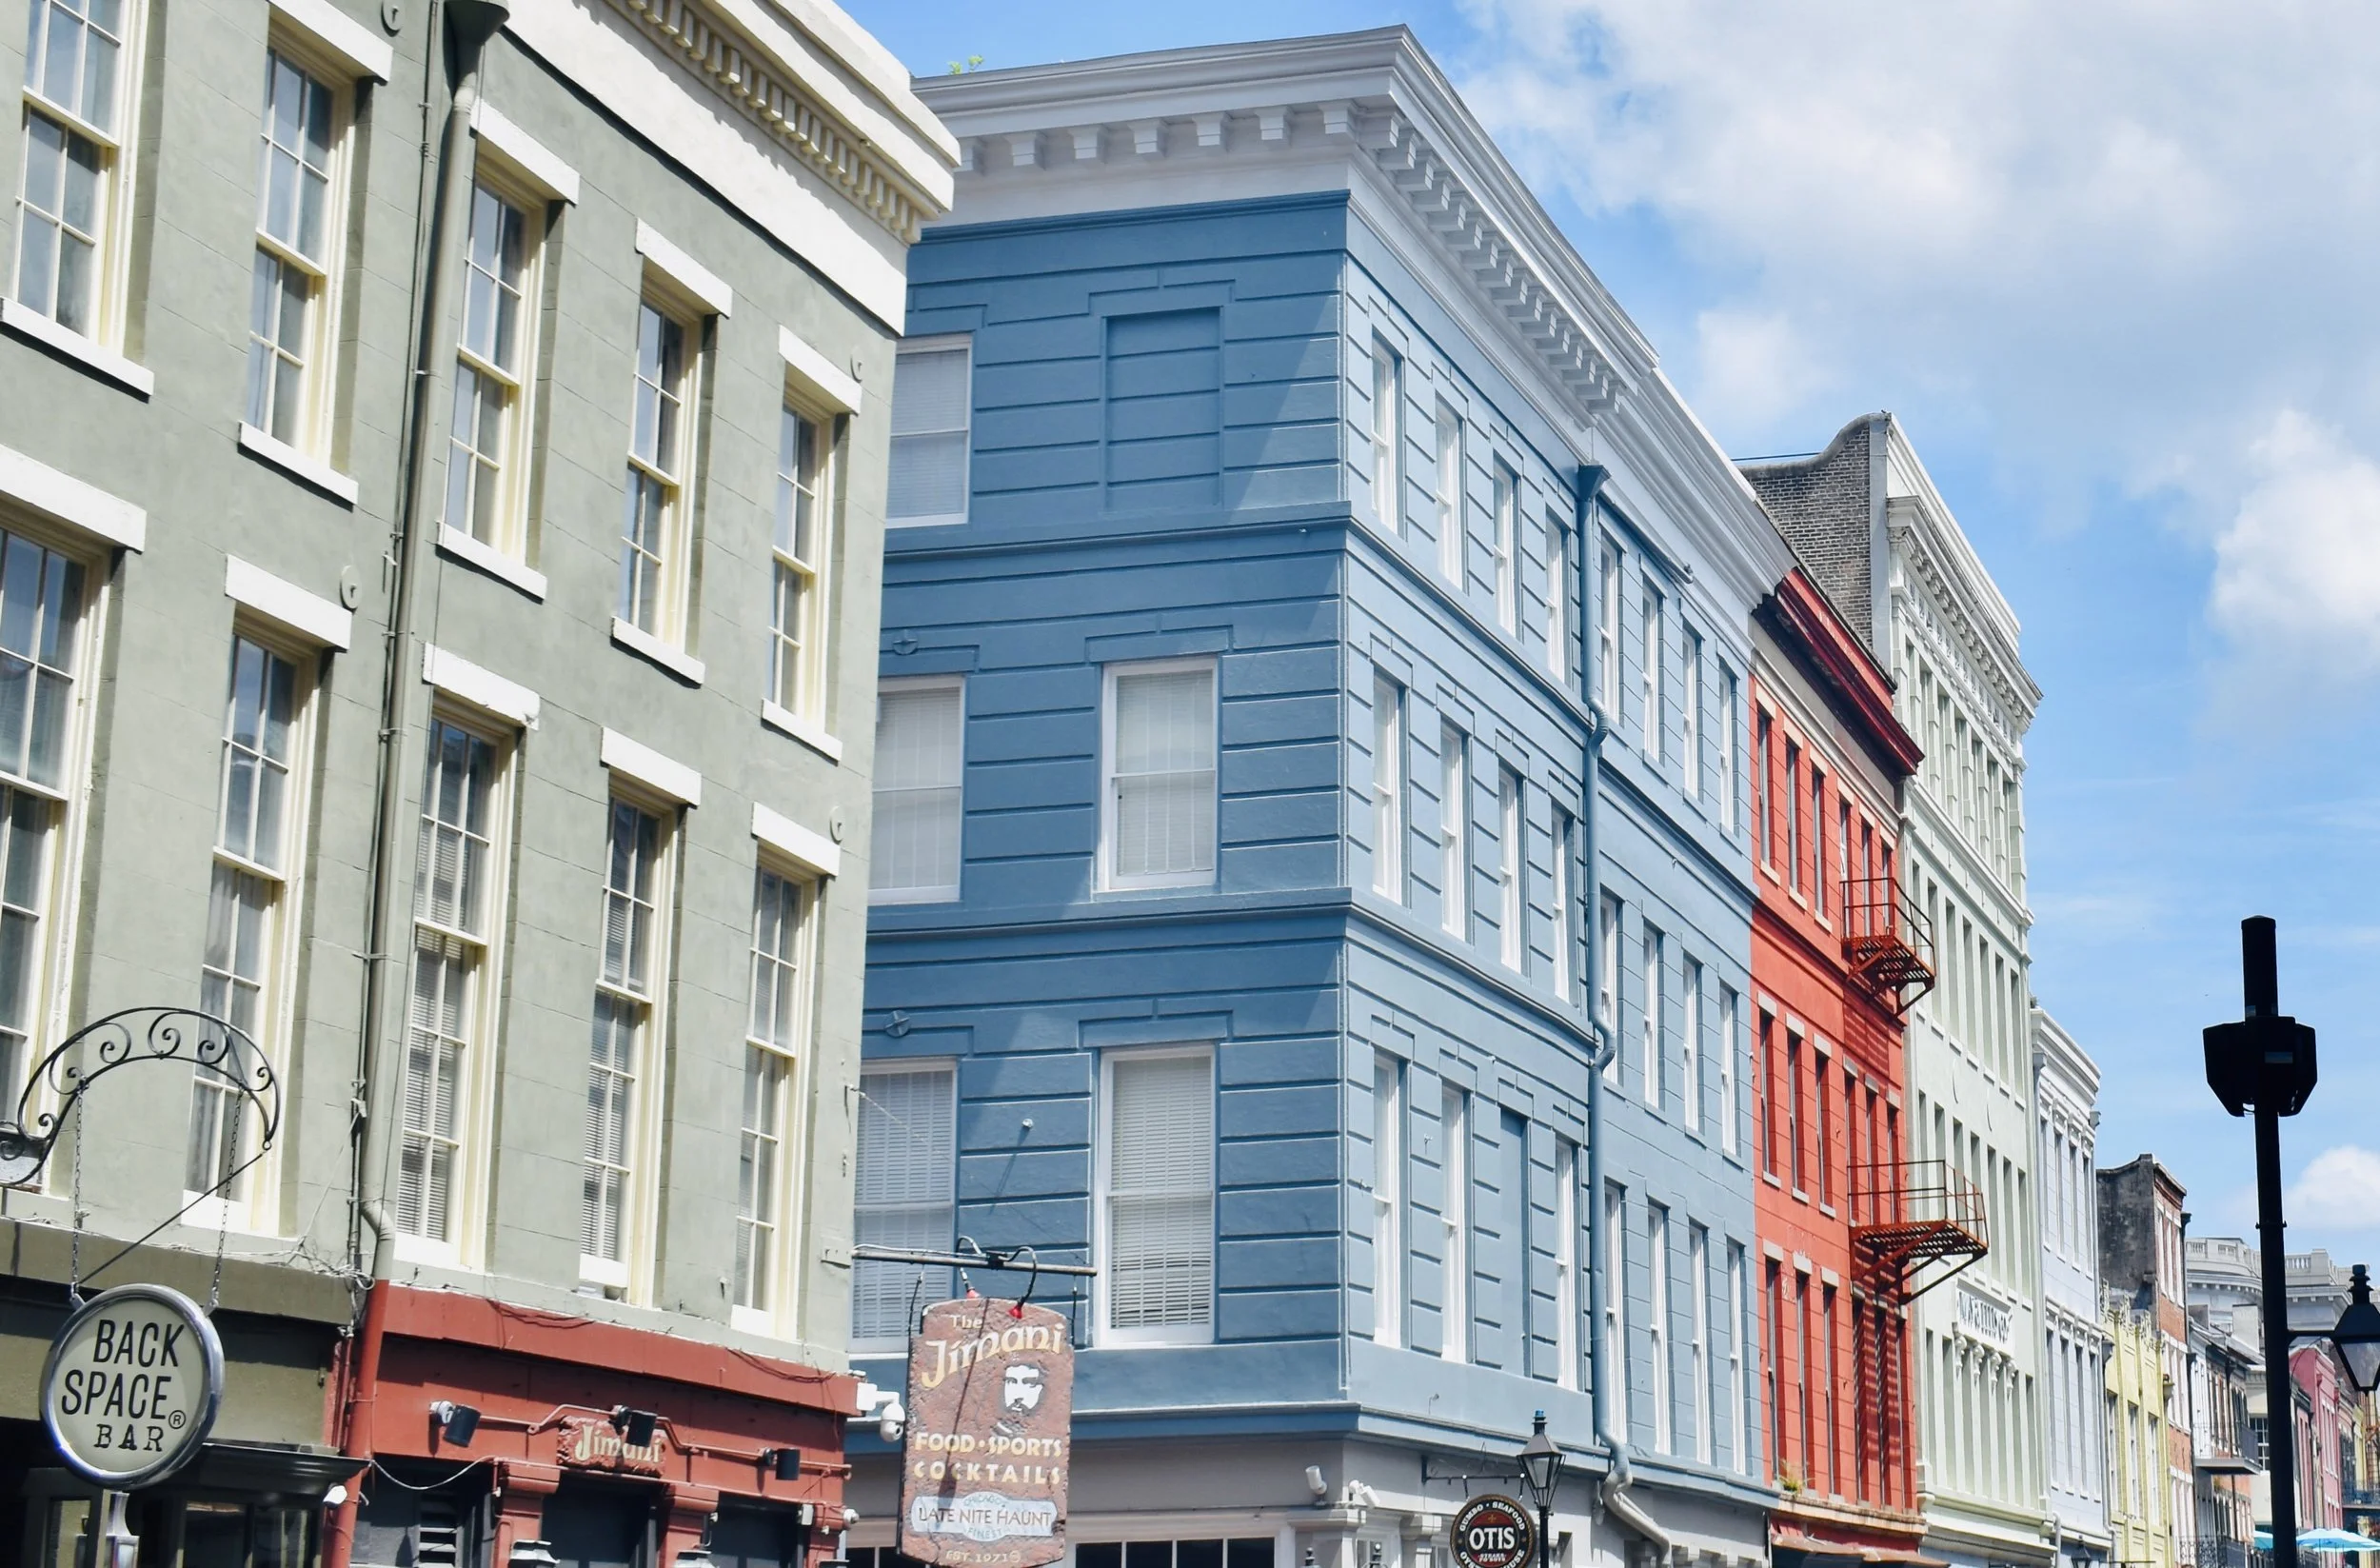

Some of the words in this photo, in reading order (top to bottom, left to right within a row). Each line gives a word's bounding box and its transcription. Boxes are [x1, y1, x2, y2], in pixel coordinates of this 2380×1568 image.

[949, 1315, 982, 1329] The
[92, 1319, 185, 1368] BACK
[921, 1322, 1065, 1388] Jimani
[61, 1369, 172, 1420] SPACE
[93, 1423, 165, 1453] BAR
[914, 1432, 976, 1453] FOOD
[986, 1436, 1062, 1458] SPORTS
[914, 1460, 1061, 1484] COCKTAILS
[918, 1507, 955, 1522] LATE
[960, 1509, 992, 1524] NITE
[997, 1510, 1052, 1526] HAUNT
[1459, 1503, 1484, 1532] GUMBO
[1492, 1501, 1526, 1531] SEAFOOD
[1469, 1526, 1516, 1551] OTIS
[976, 1553, 1008, 1563] 1971
